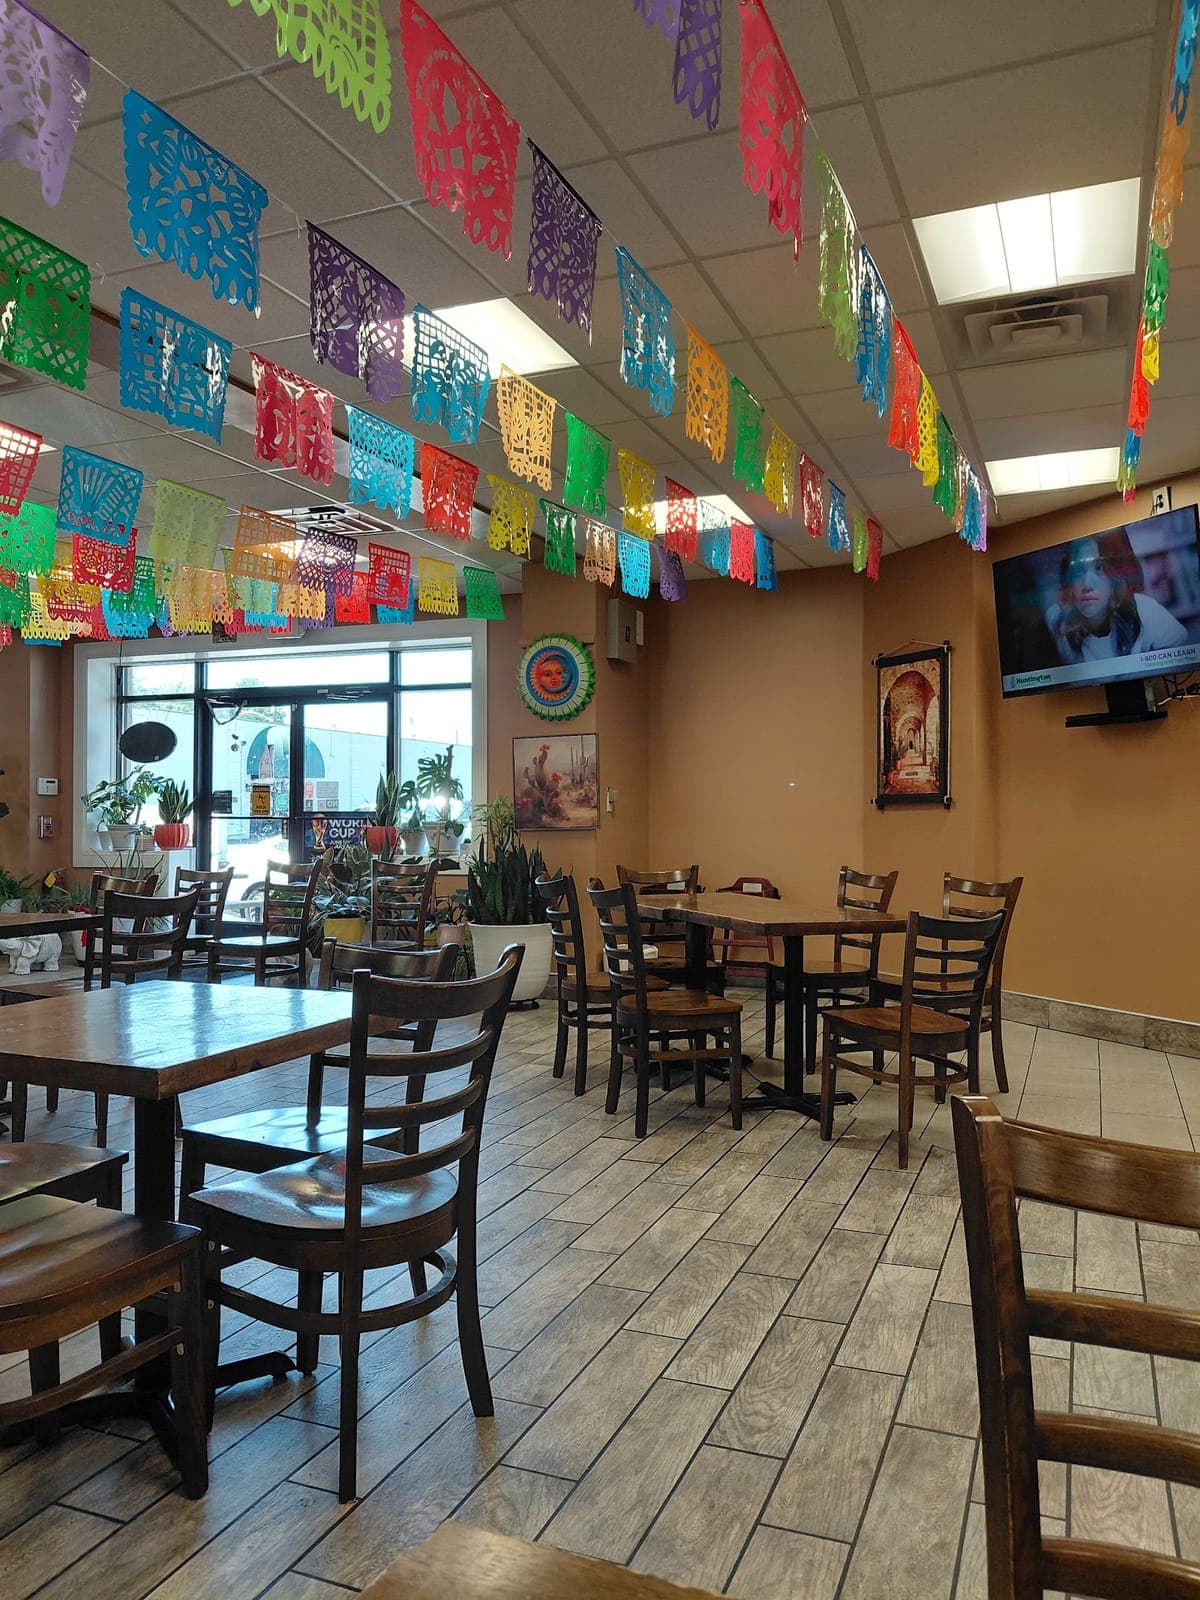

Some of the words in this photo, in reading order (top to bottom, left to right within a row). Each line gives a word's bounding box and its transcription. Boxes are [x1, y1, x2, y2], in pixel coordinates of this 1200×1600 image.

[1158, 652, 1172, 660] CAN
[1173, 648, 1196, 657] LEARN
[1016, 674, 1051, 683] Huntington
[329, 828, 355, 838] CUP
